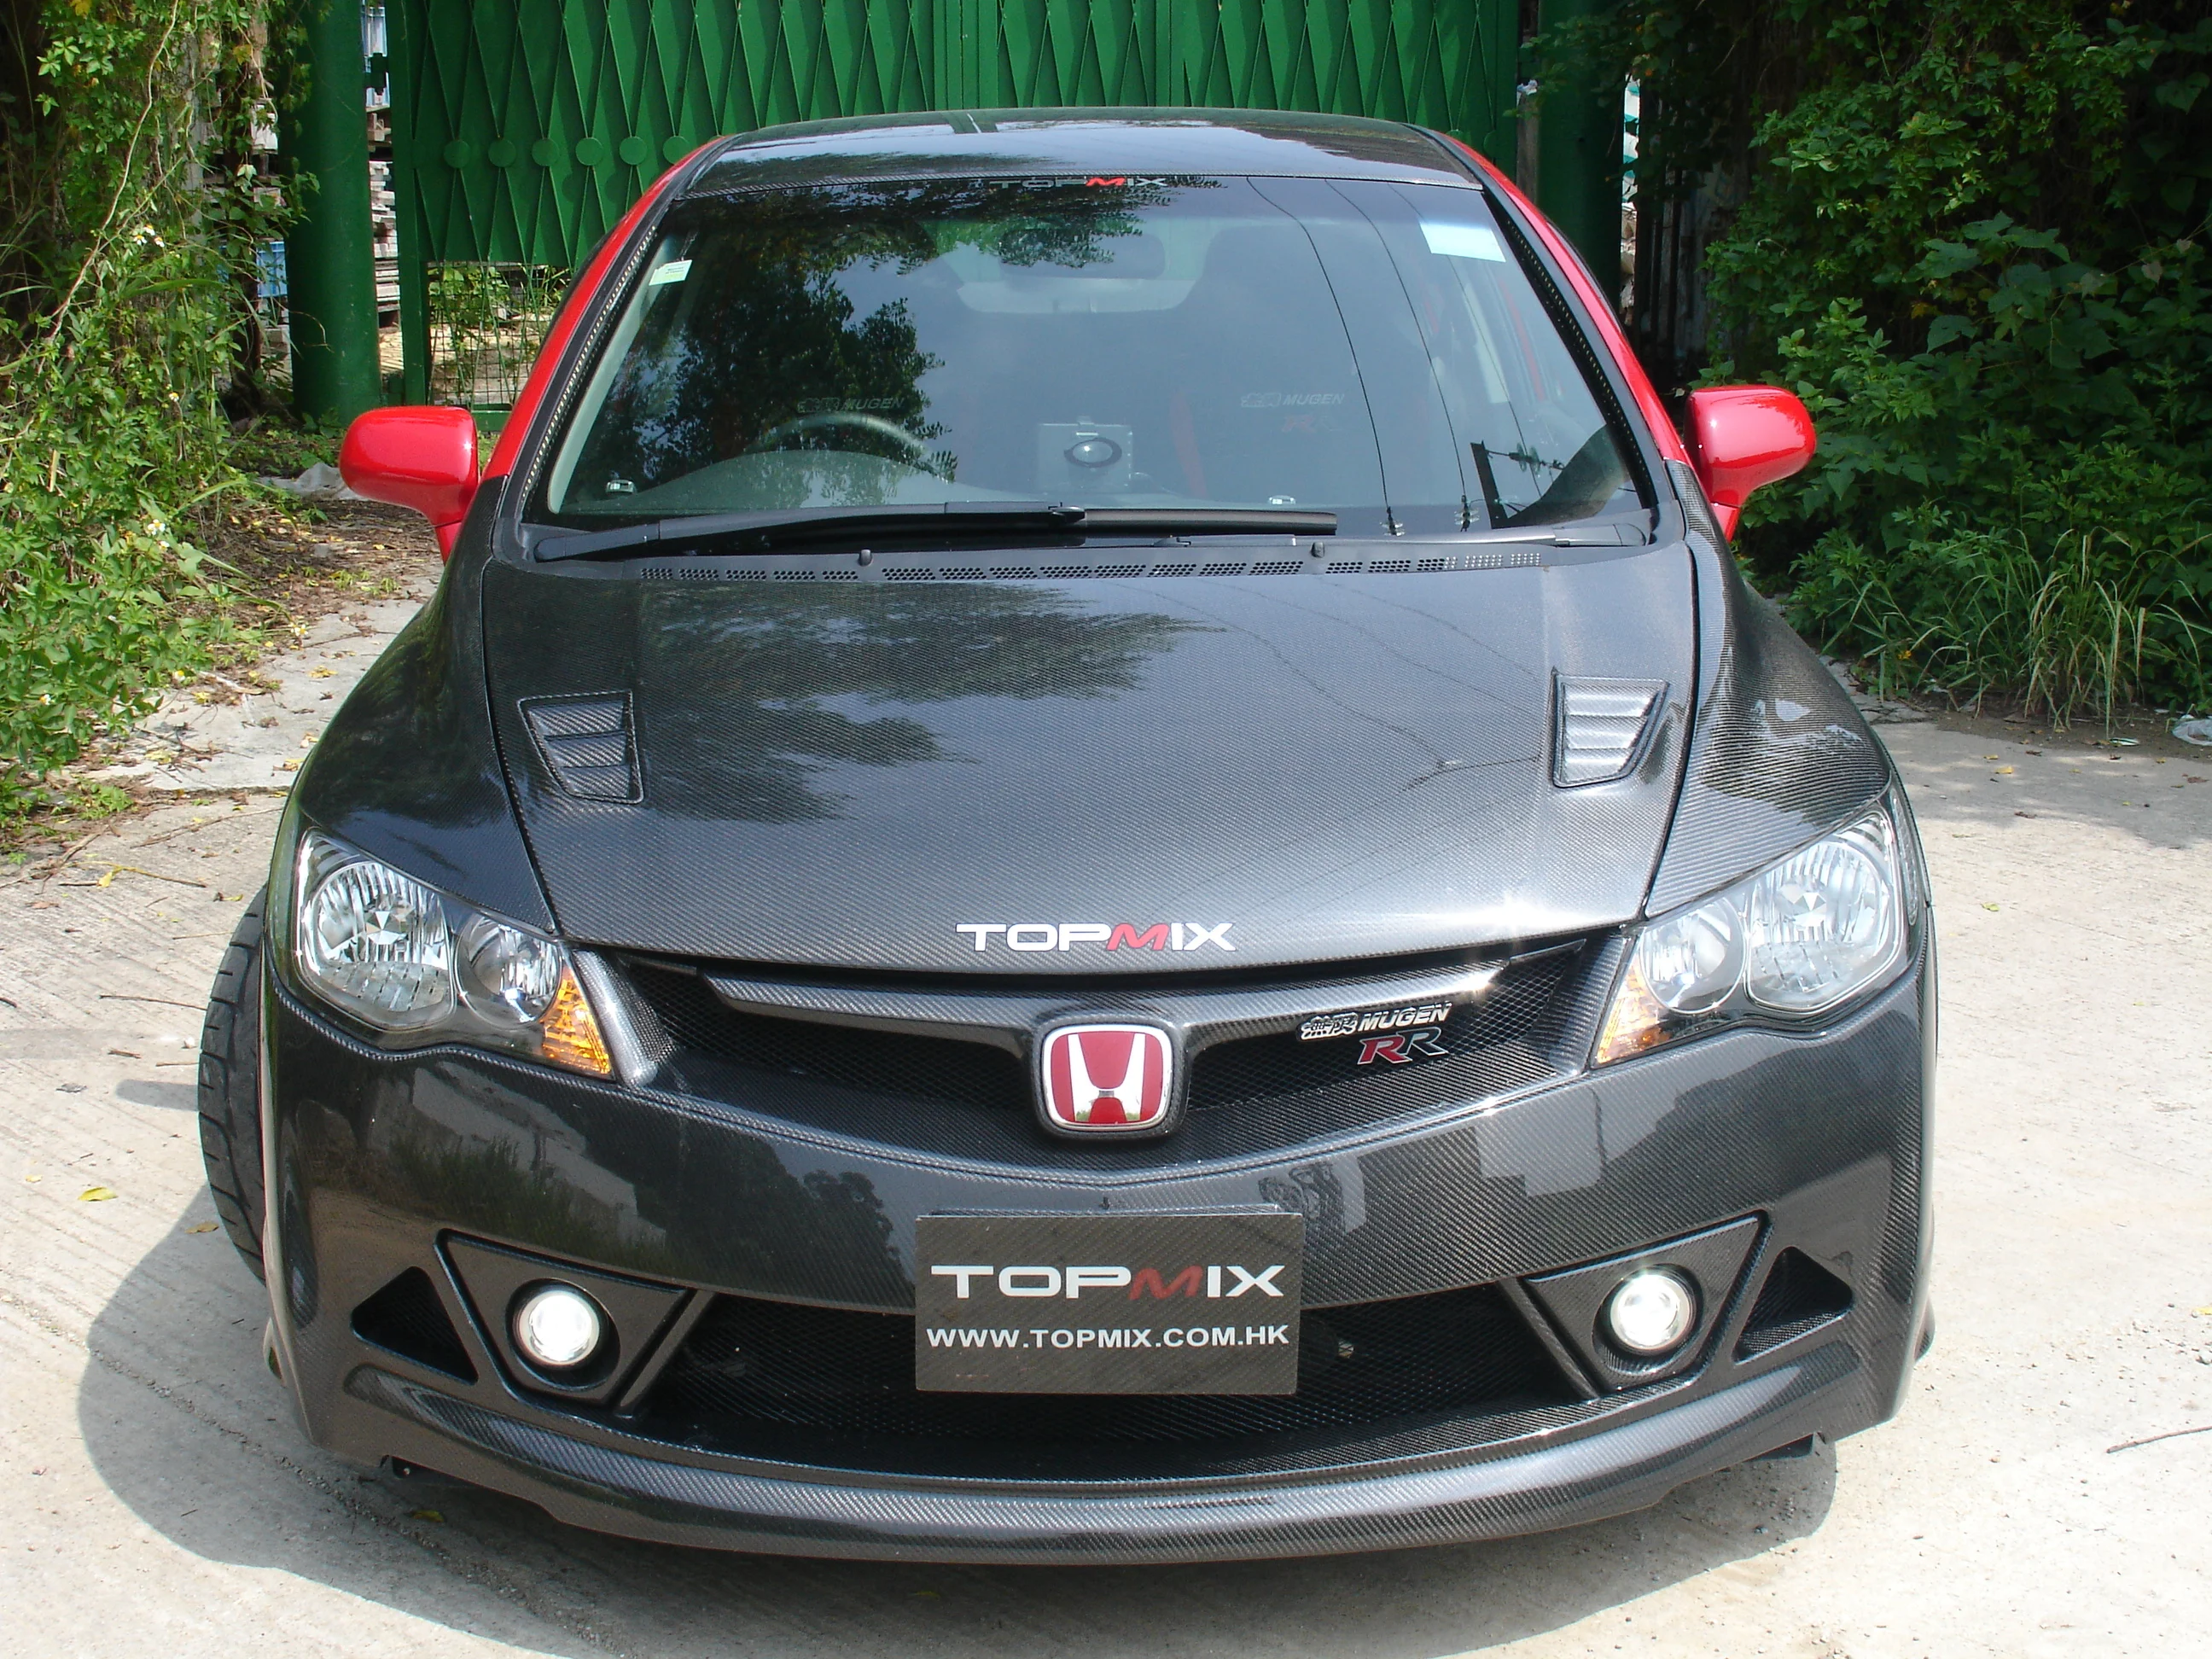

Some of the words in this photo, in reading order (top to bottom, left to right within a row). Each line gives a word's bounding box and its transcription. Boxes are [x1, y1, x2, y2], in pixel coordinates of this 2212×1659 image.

[989, 177, 1168, 189] TOPMIX
[1283, 393, 1345, 405] MUGEN
[956, 923, 1236, 952] TOPMIX
[1358, 1002, 1452, 1032] MUGEN
[1357, 1027, 1450, 1065] RR
[931, 1265, 1285, 1300] TOPMIX
[927, 1324, 1289, 1348] WWW.TOPMIX.COM.HK
